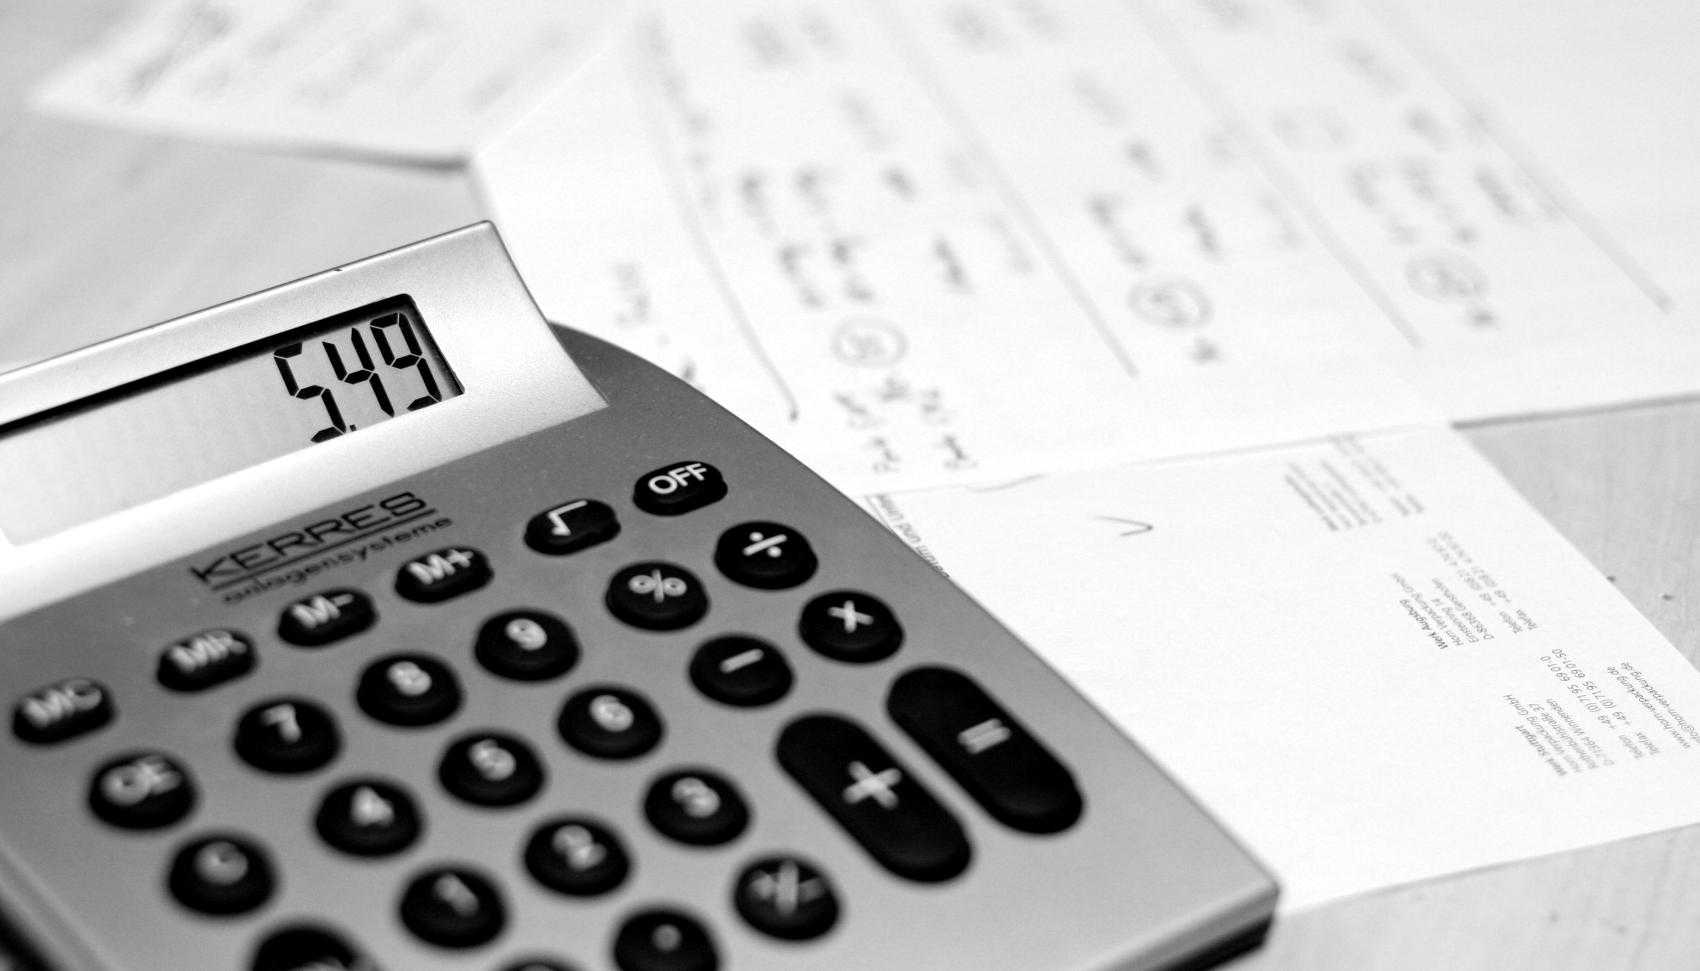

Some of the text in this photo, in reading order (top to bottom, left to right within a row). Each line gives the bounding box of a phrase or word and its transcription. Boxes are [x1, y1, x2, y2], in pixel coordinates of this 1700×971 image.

[272, 311, 443, 444] 5.49
[648, 463, 707, 495] OFF
[191, 491, 427, 584] KERRES
[223, 517, 453, 603] anlagensysteme
[404, 544, 474, 588] M+
[505, 617, 547, 650] 9
[1400, 599, 1448, 649] Werk Augsburg
[1446, 630, 1464, 646] Horn
[388, 661, 432, 696] 8
[260, 703, 301, 743] 7
[589, 695, 634, 732] 6
[1503, 694, 1529, 716] GmbH
[469, 739, 516, 780] 5
[1516, 725, 1551, 757] Stuttgart
[351, 787, 394, 825] 4
[671, 777, 720, 818] 3
[552, 824, 607, 870] 2
[433, 873, 479, 917] 1
